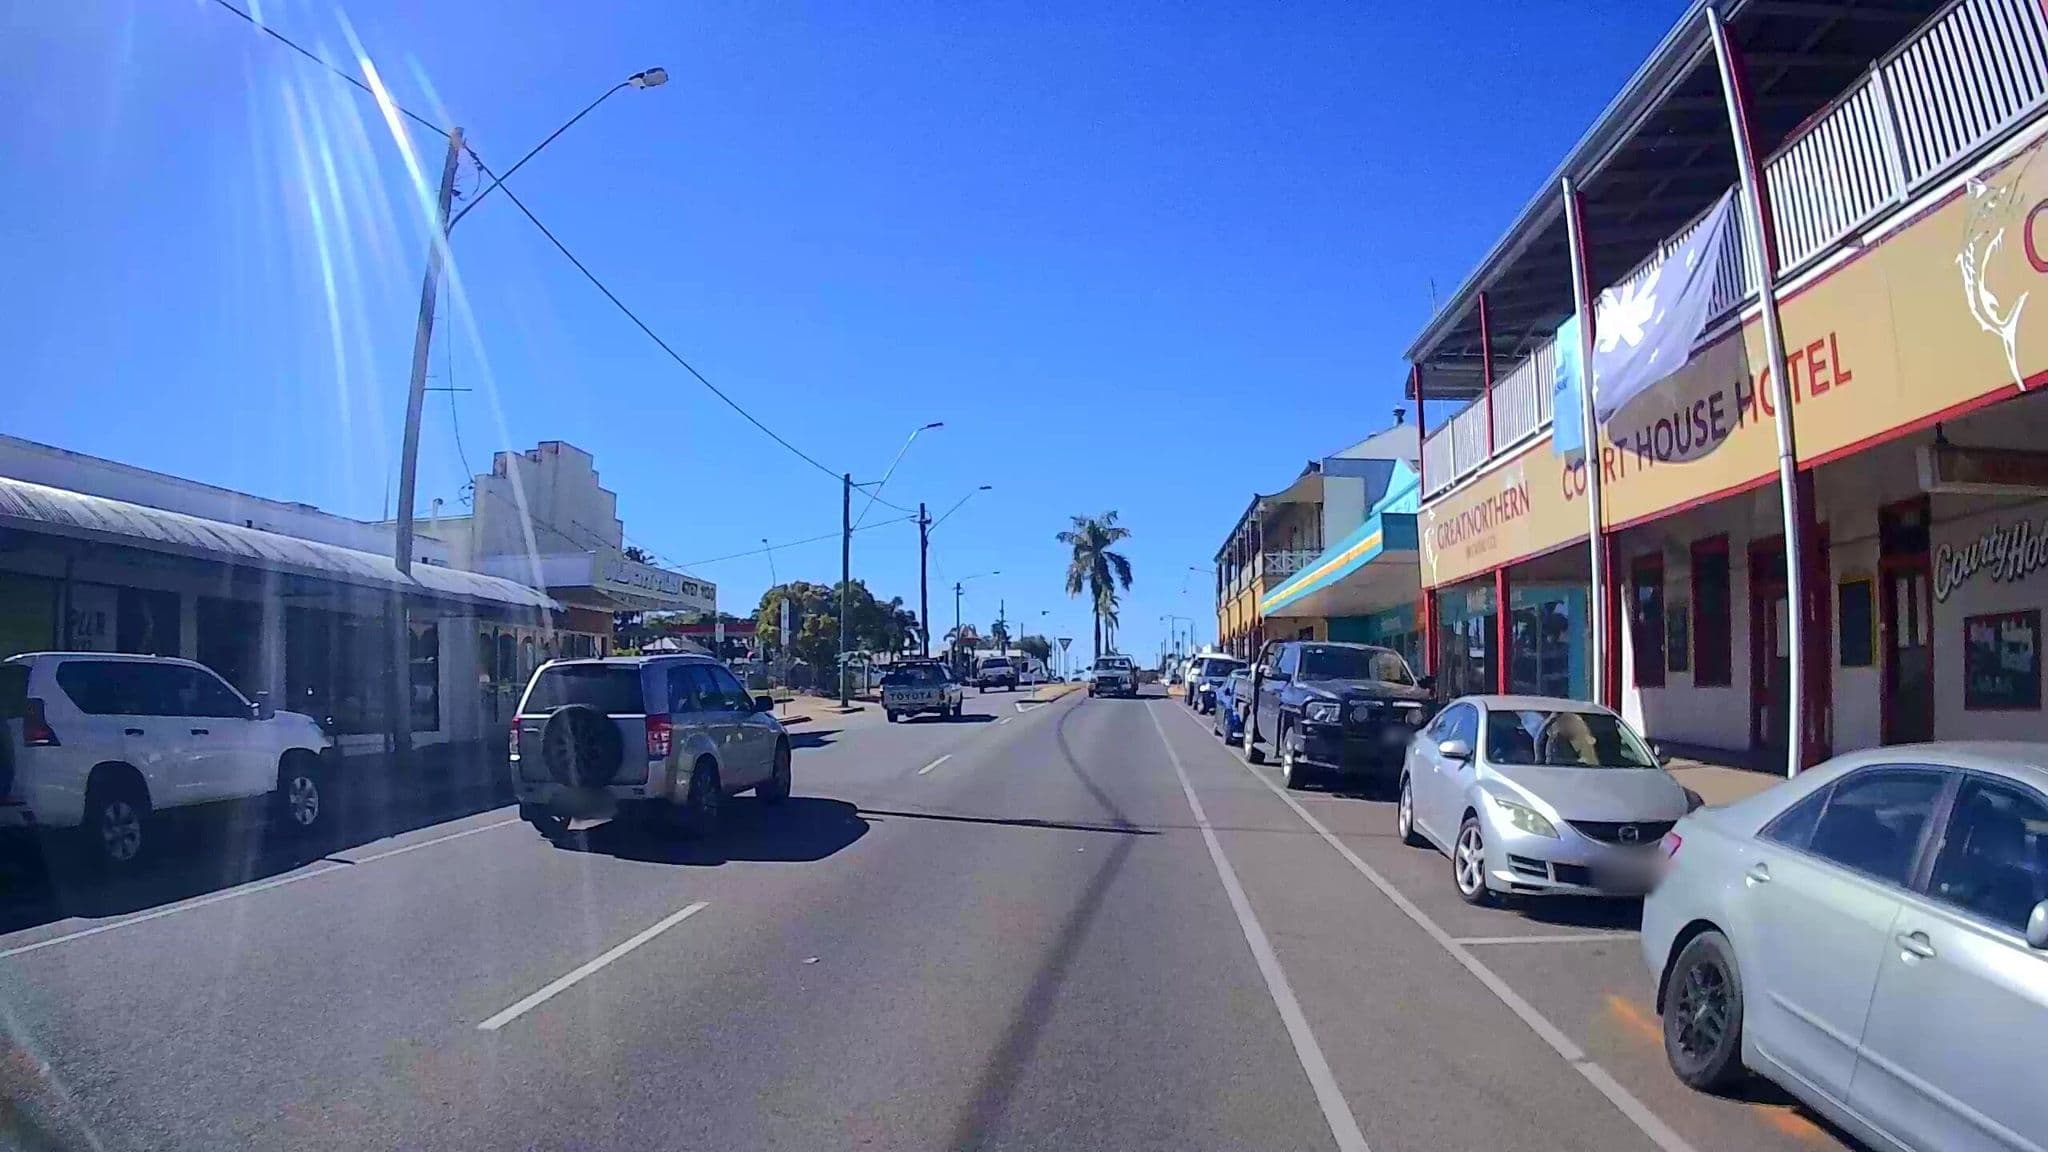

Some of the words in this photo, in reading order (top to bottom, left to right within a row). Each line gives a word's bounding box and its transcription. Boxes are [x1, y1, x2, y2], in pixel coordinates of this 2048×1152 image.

[1562, 437, 1627, 500] CORT
[1635, 390, 1728, 471] HOUSE
[889, 692, 932, 701] TOYOTA
